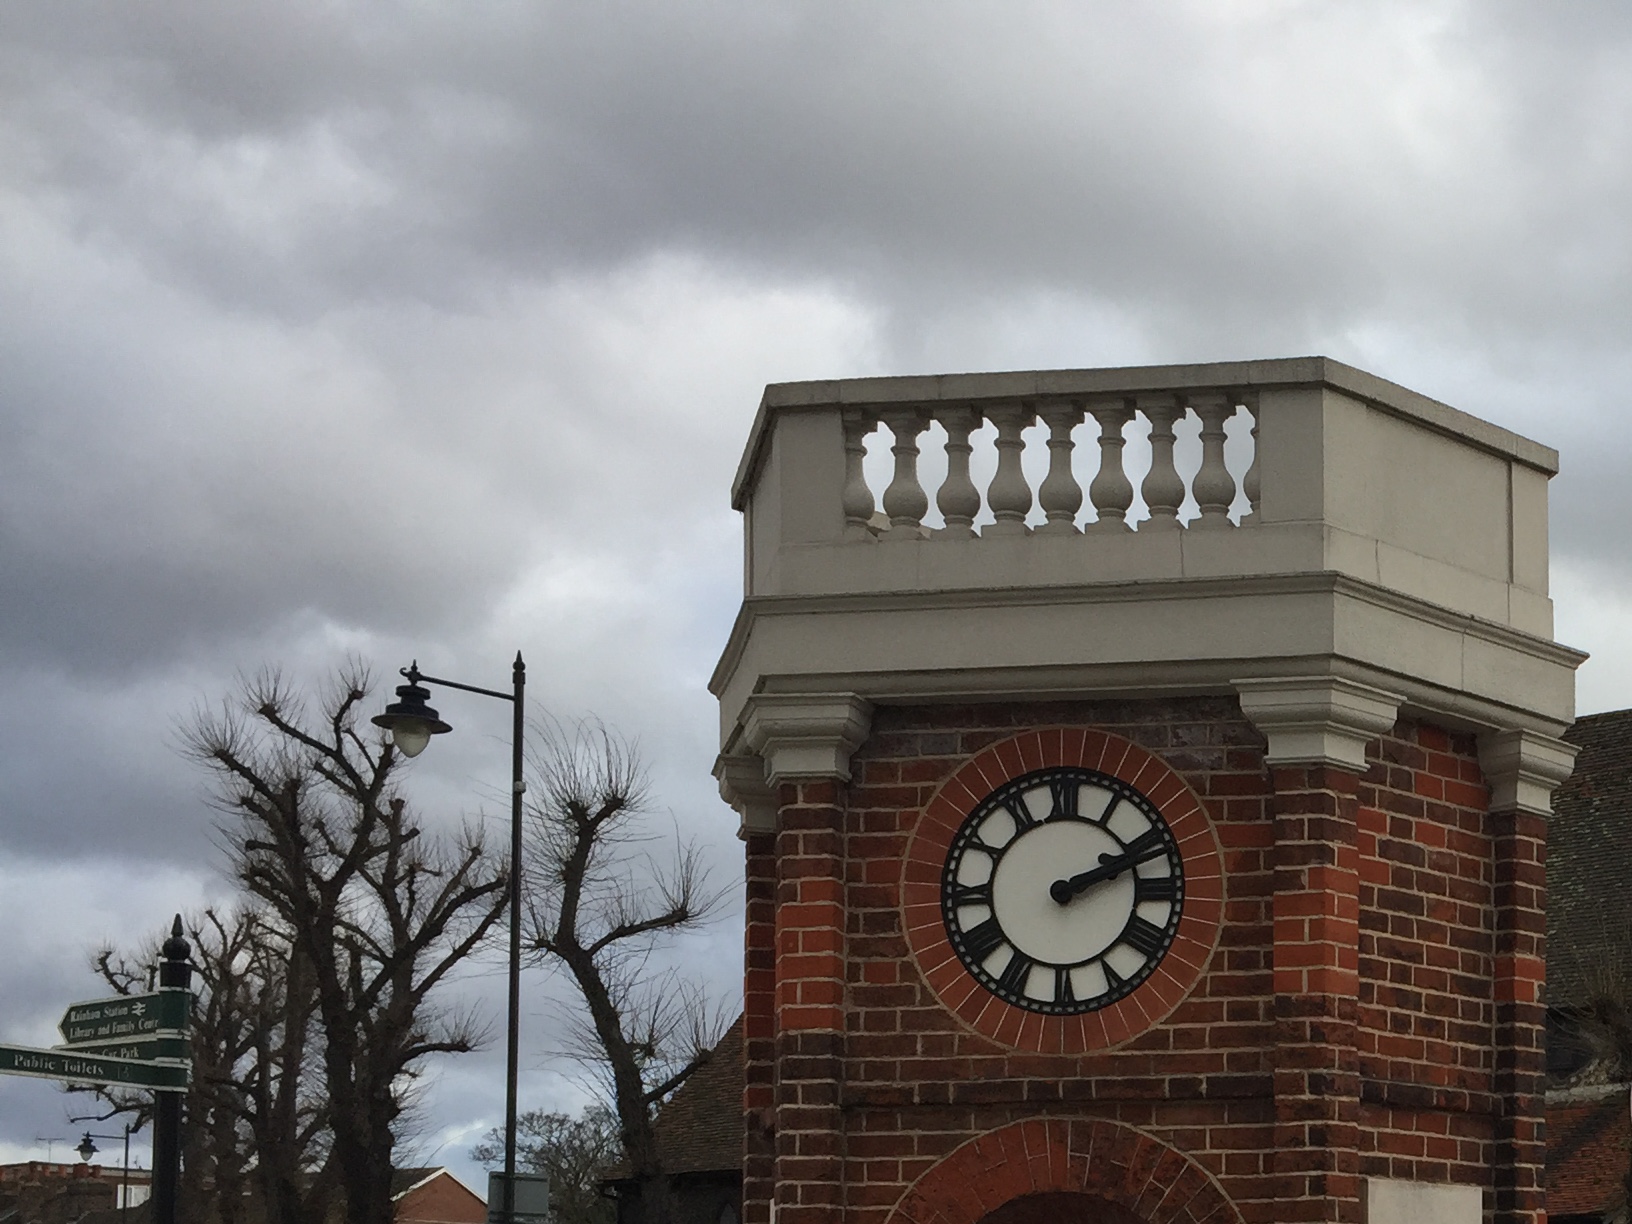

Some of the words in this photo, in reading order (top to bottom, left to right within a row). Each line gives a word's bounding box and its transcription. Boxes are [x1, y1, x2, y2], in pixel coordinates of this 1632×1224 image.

[103, 1005, 129, 1018] Station
[69, 1027, 95, 1039] Library
[98, 1024, 110, 1035] and
[112, 1021, 135, 1034] Family
[14, 1054, 56, 1071] Public
[61, 1059, 104, 1076] Toilets
